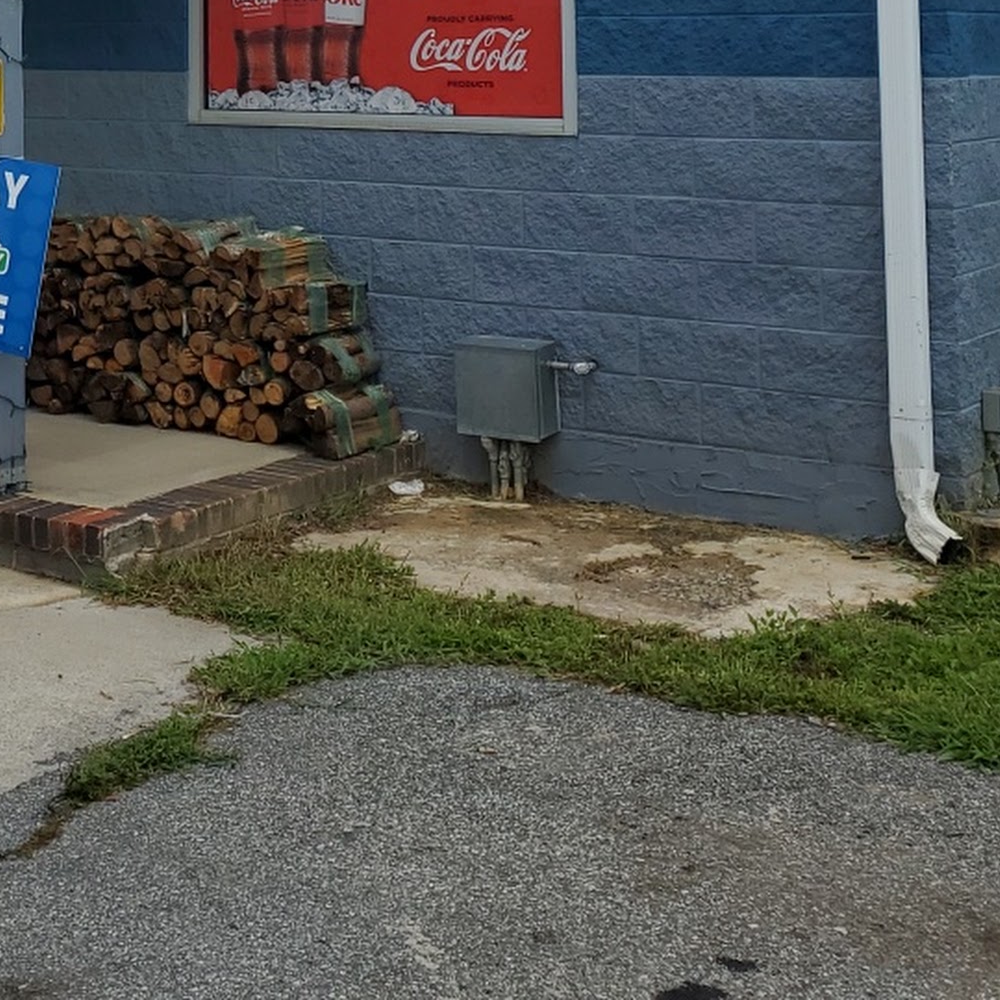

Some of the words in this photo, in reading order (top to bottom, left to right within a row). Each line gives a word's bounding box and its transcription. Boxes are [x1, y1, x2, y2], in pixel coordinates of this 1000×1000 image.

[427, 15, 466, 23] PROUDLY
[468, 14, 514, 23] CARRYING
[409, 27, 531, 72] Coca-Cola
[446, 80, 495, 88] PRODUCTS
